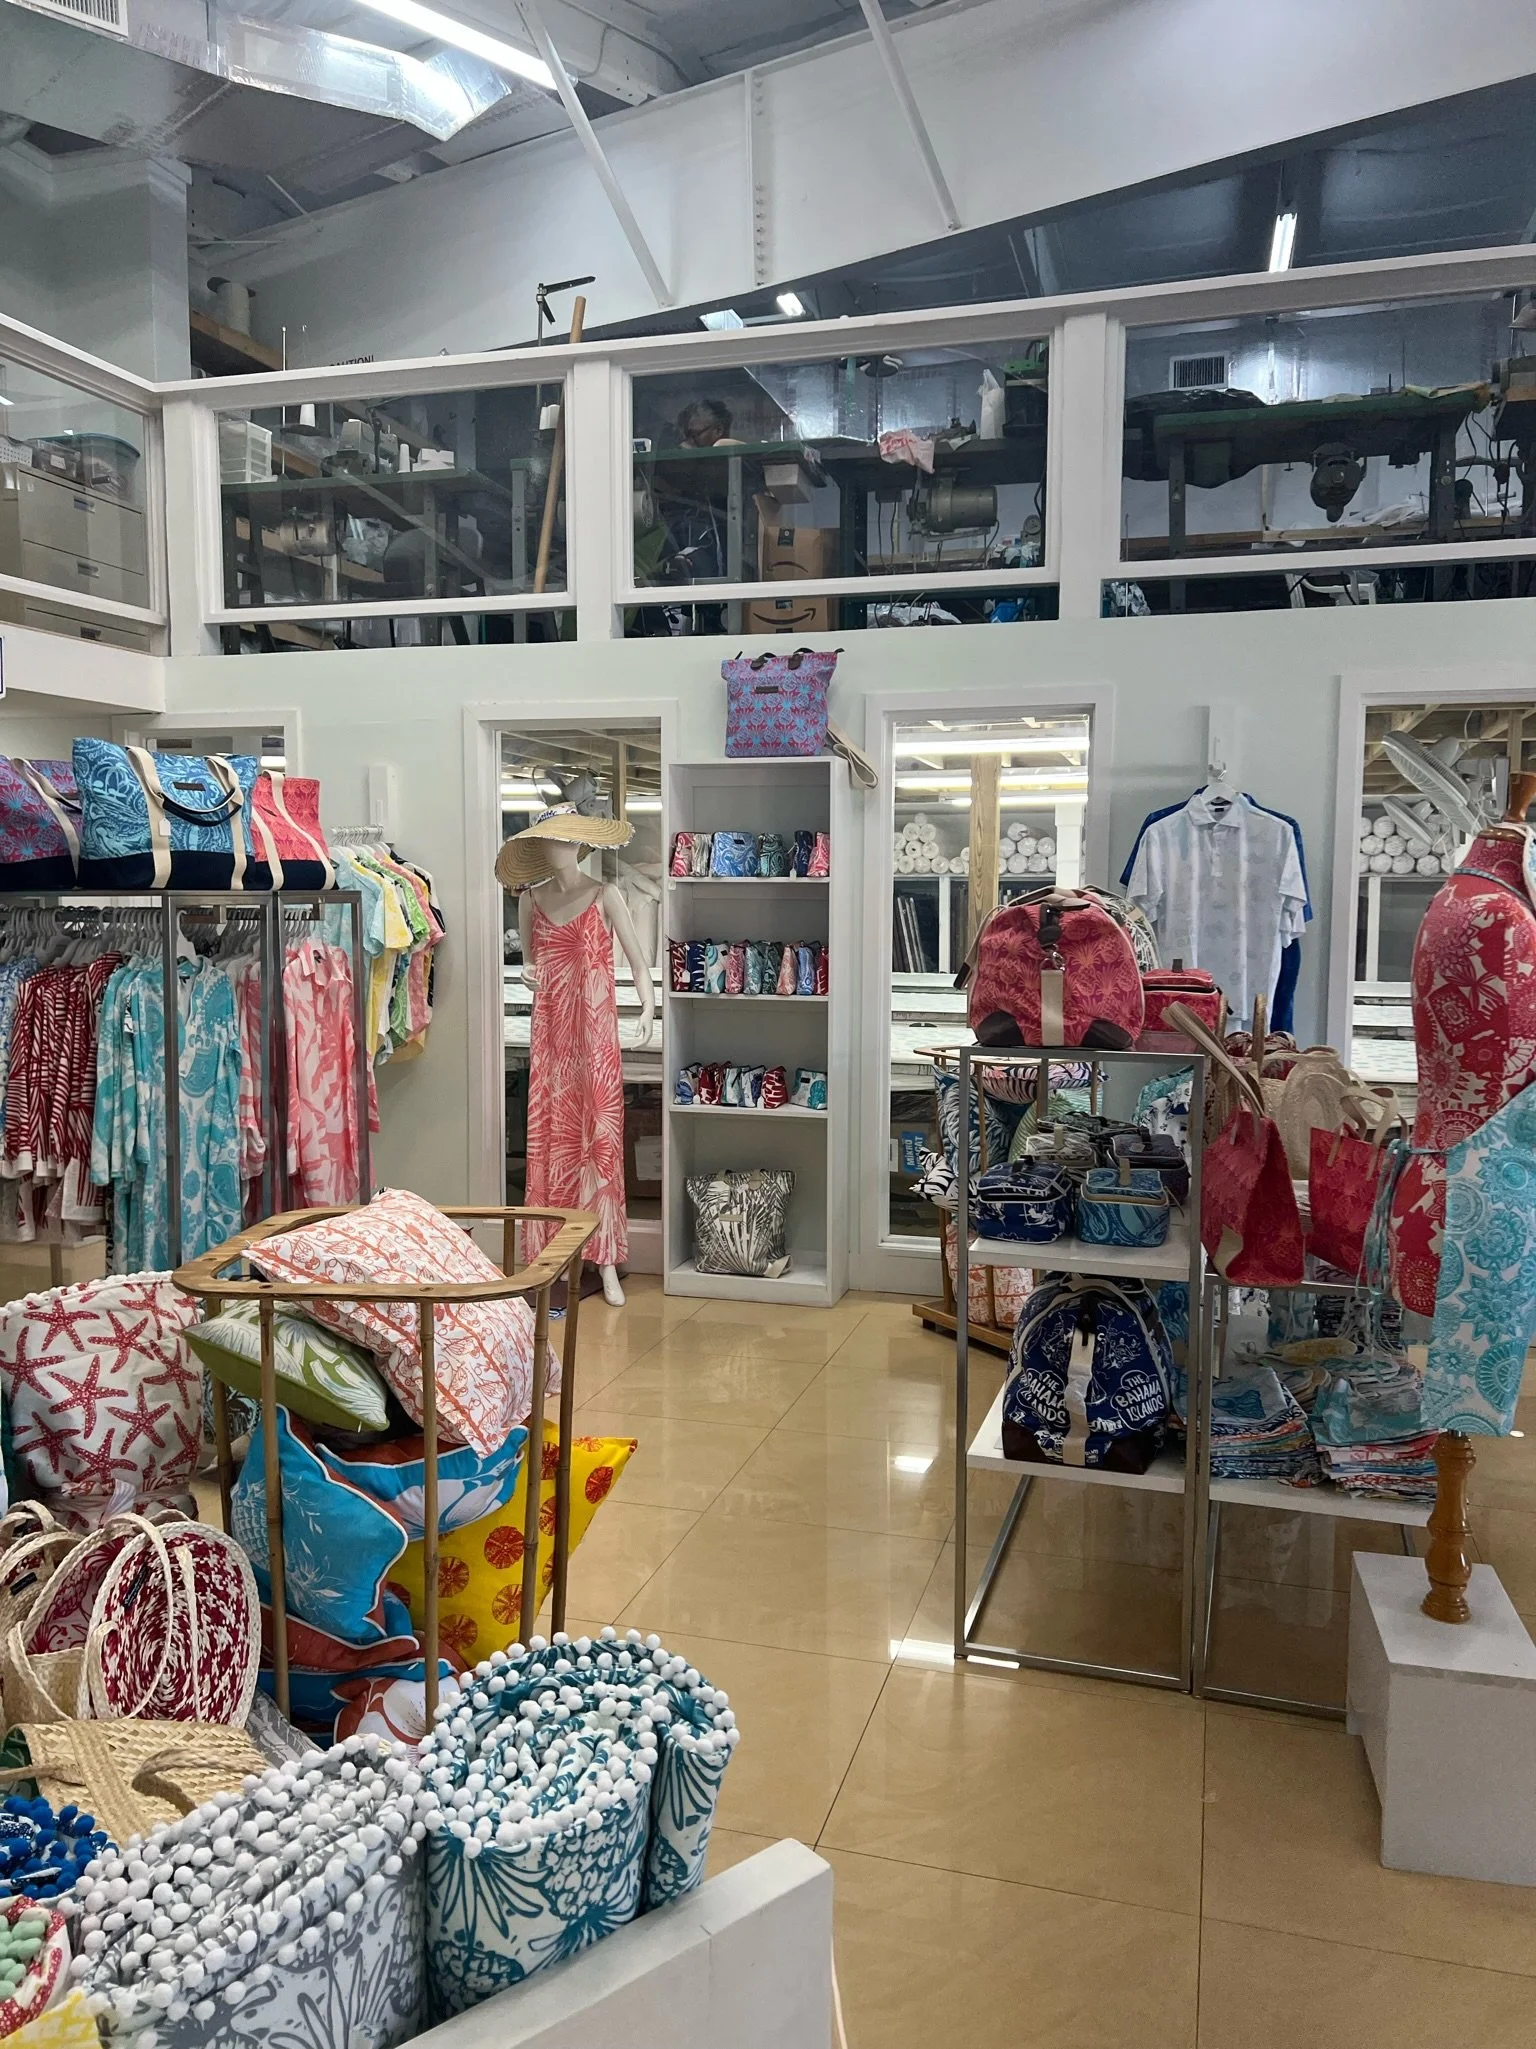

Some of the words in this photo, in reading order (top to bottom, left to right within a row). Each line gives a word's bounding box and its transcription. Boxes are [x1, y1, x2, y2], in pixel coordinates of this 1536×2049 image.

[1042, 1373, 1060, 1392] THE
[1125, 1374, 1146, 1388] THE
[1126, 1395, 1165, 1422] ISLANDS
